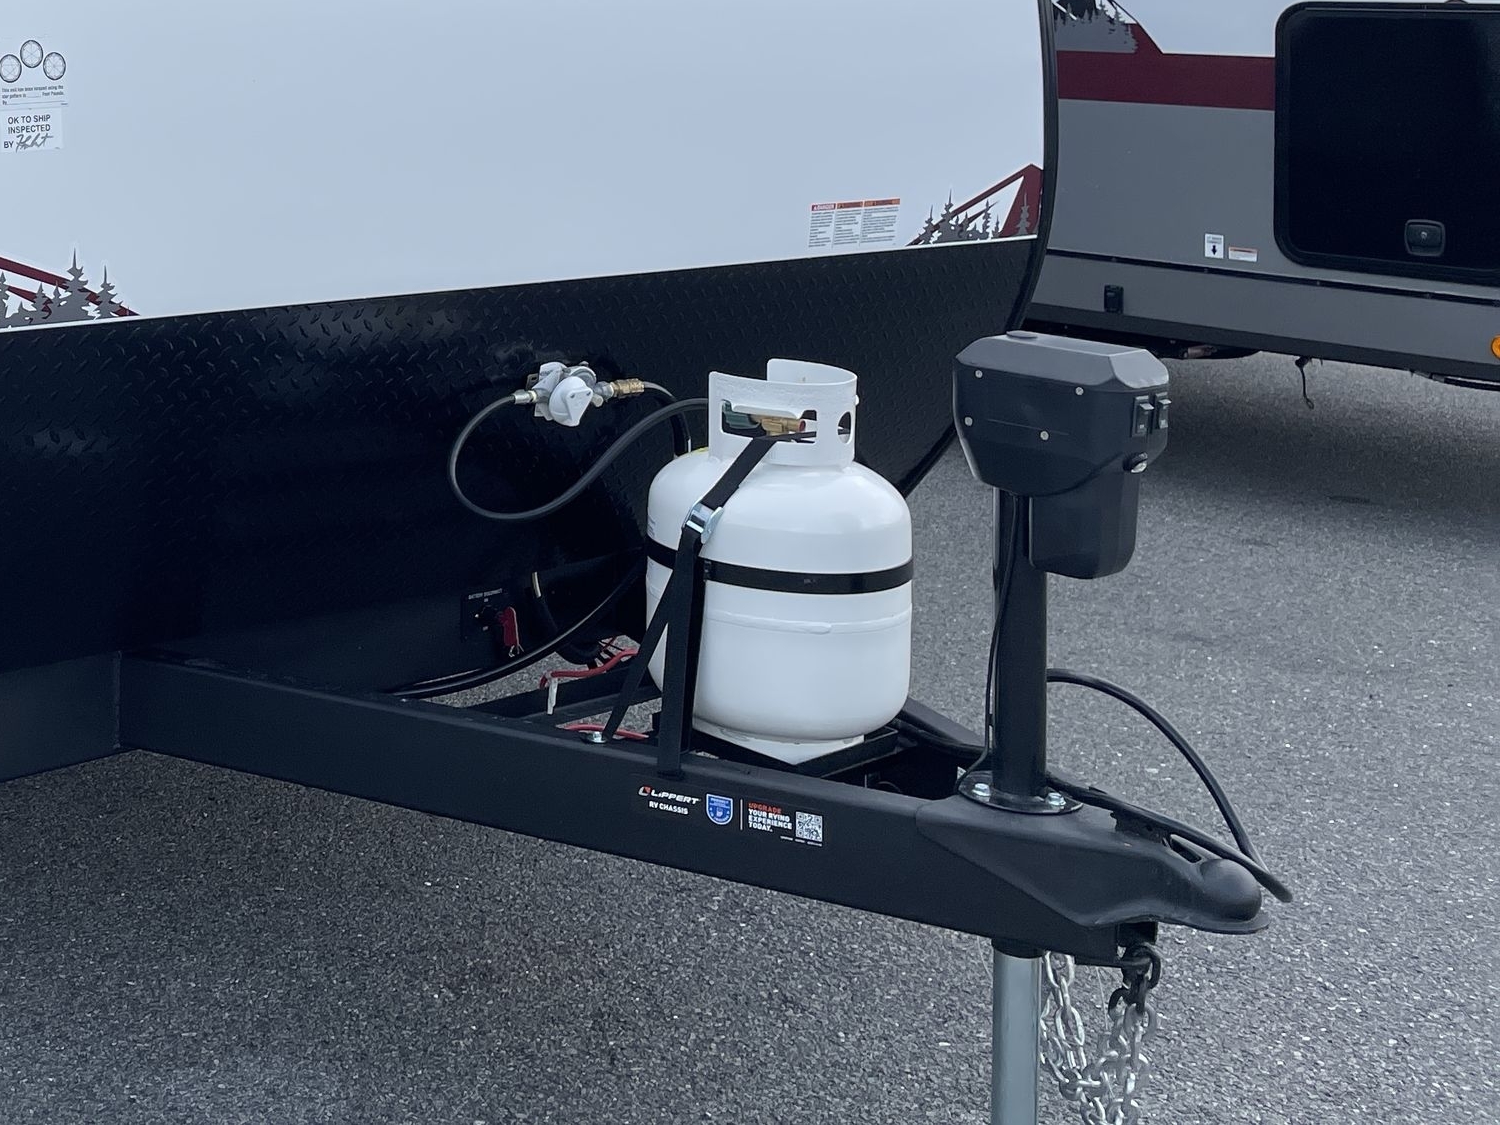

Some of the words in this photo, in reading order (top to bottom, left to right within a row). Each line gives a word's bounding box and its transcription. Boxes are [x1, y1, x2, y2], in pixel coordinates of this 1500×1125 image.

[7, 116, 19, 125] OK
[21, 115, 32, 124] TO
[33, 114, 51, 123] SHIP
[7, 124, 51, 135] INSPECTED
[3, 140, 14, 149] BY
[648, 800, 659, 809] RV
[659, 802, 689, 815] CHASSIS
[748, 803, 782, 814] UPGRADE
[748, 808, 768, 818] YOUR
[748, 815, 793, 830] EXPERIENCE
[748, 821, 774, 832] TODAY.
